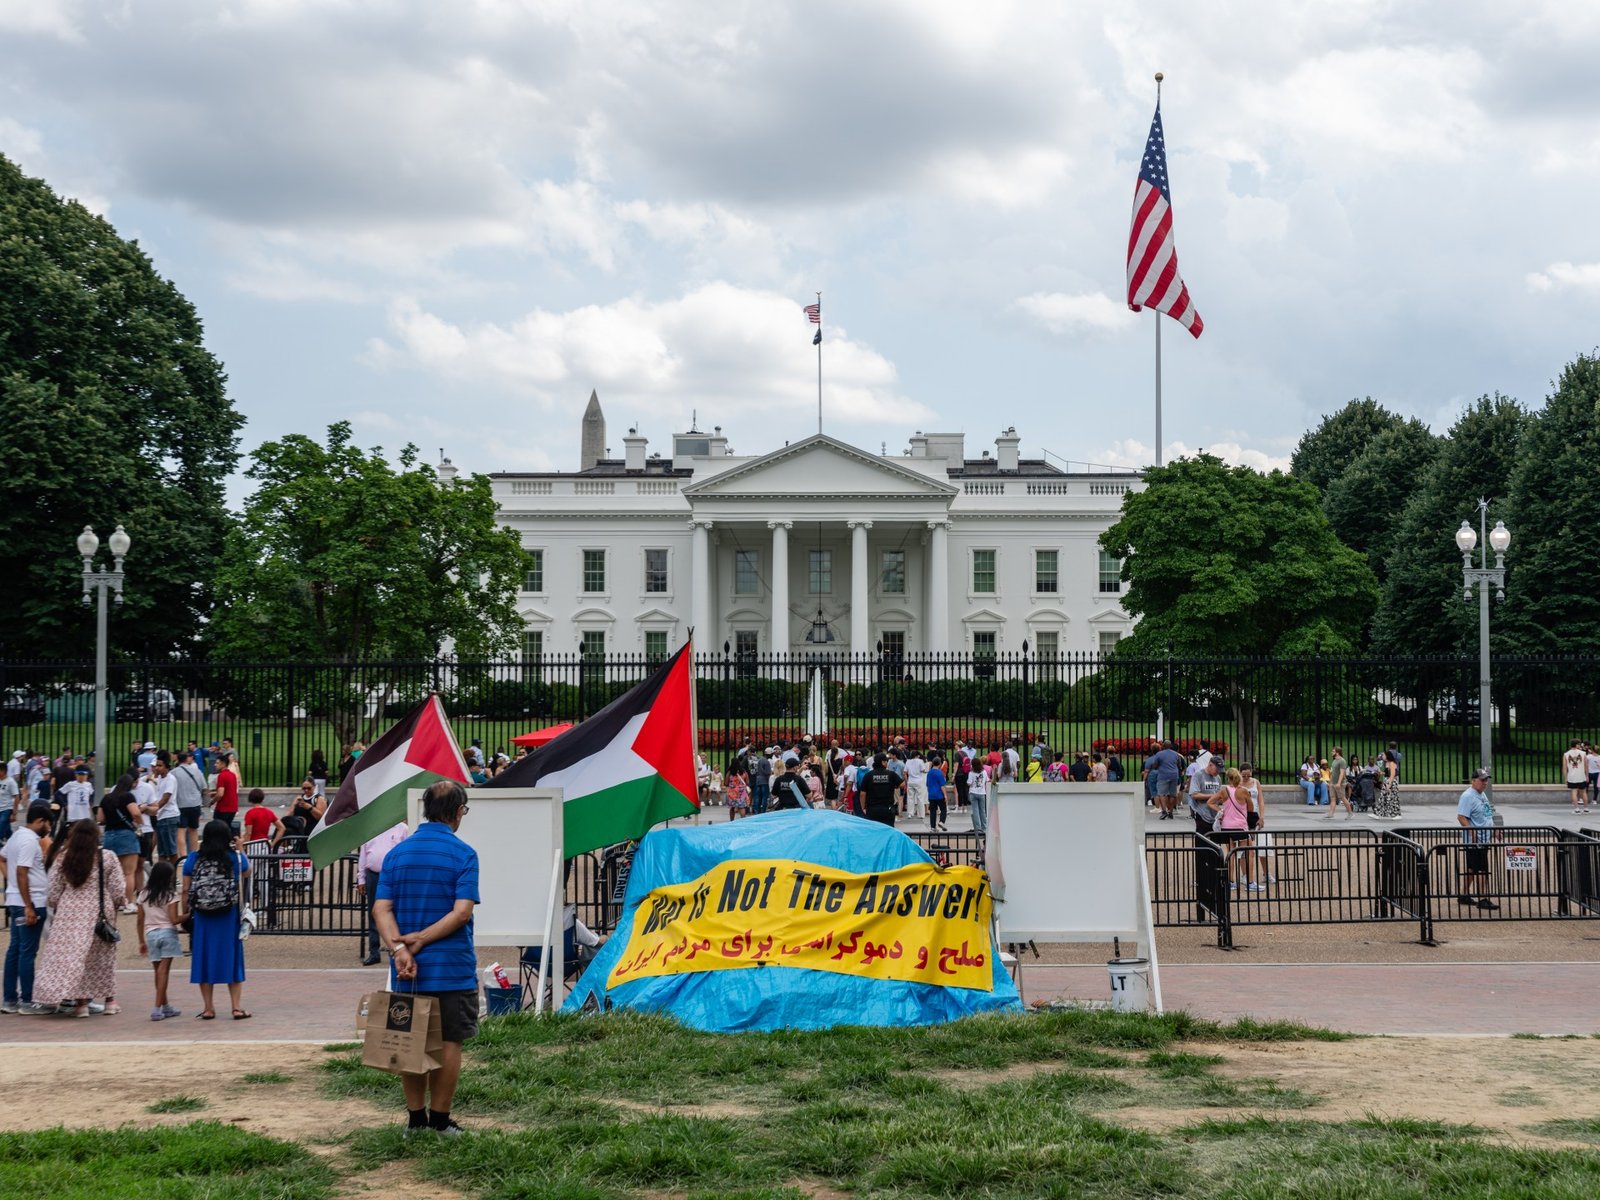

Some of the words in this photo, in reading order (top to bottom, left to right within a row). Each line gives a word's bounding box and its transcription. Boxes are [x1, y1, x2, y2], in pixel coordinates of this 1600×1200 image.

[614, 868, 630, 899] STAND
[717, 867, 776, 913] Not
[788, 869, 846, 913] The
[853, 875, 986, 922] Answer!
[615, 942, 664, 976] ایران
[663, 936, 711, 967] مردم
[721, 929, 774, 960] برای
[914, 946, 929, 969] و
[938, 940, 985, 974] صلح
